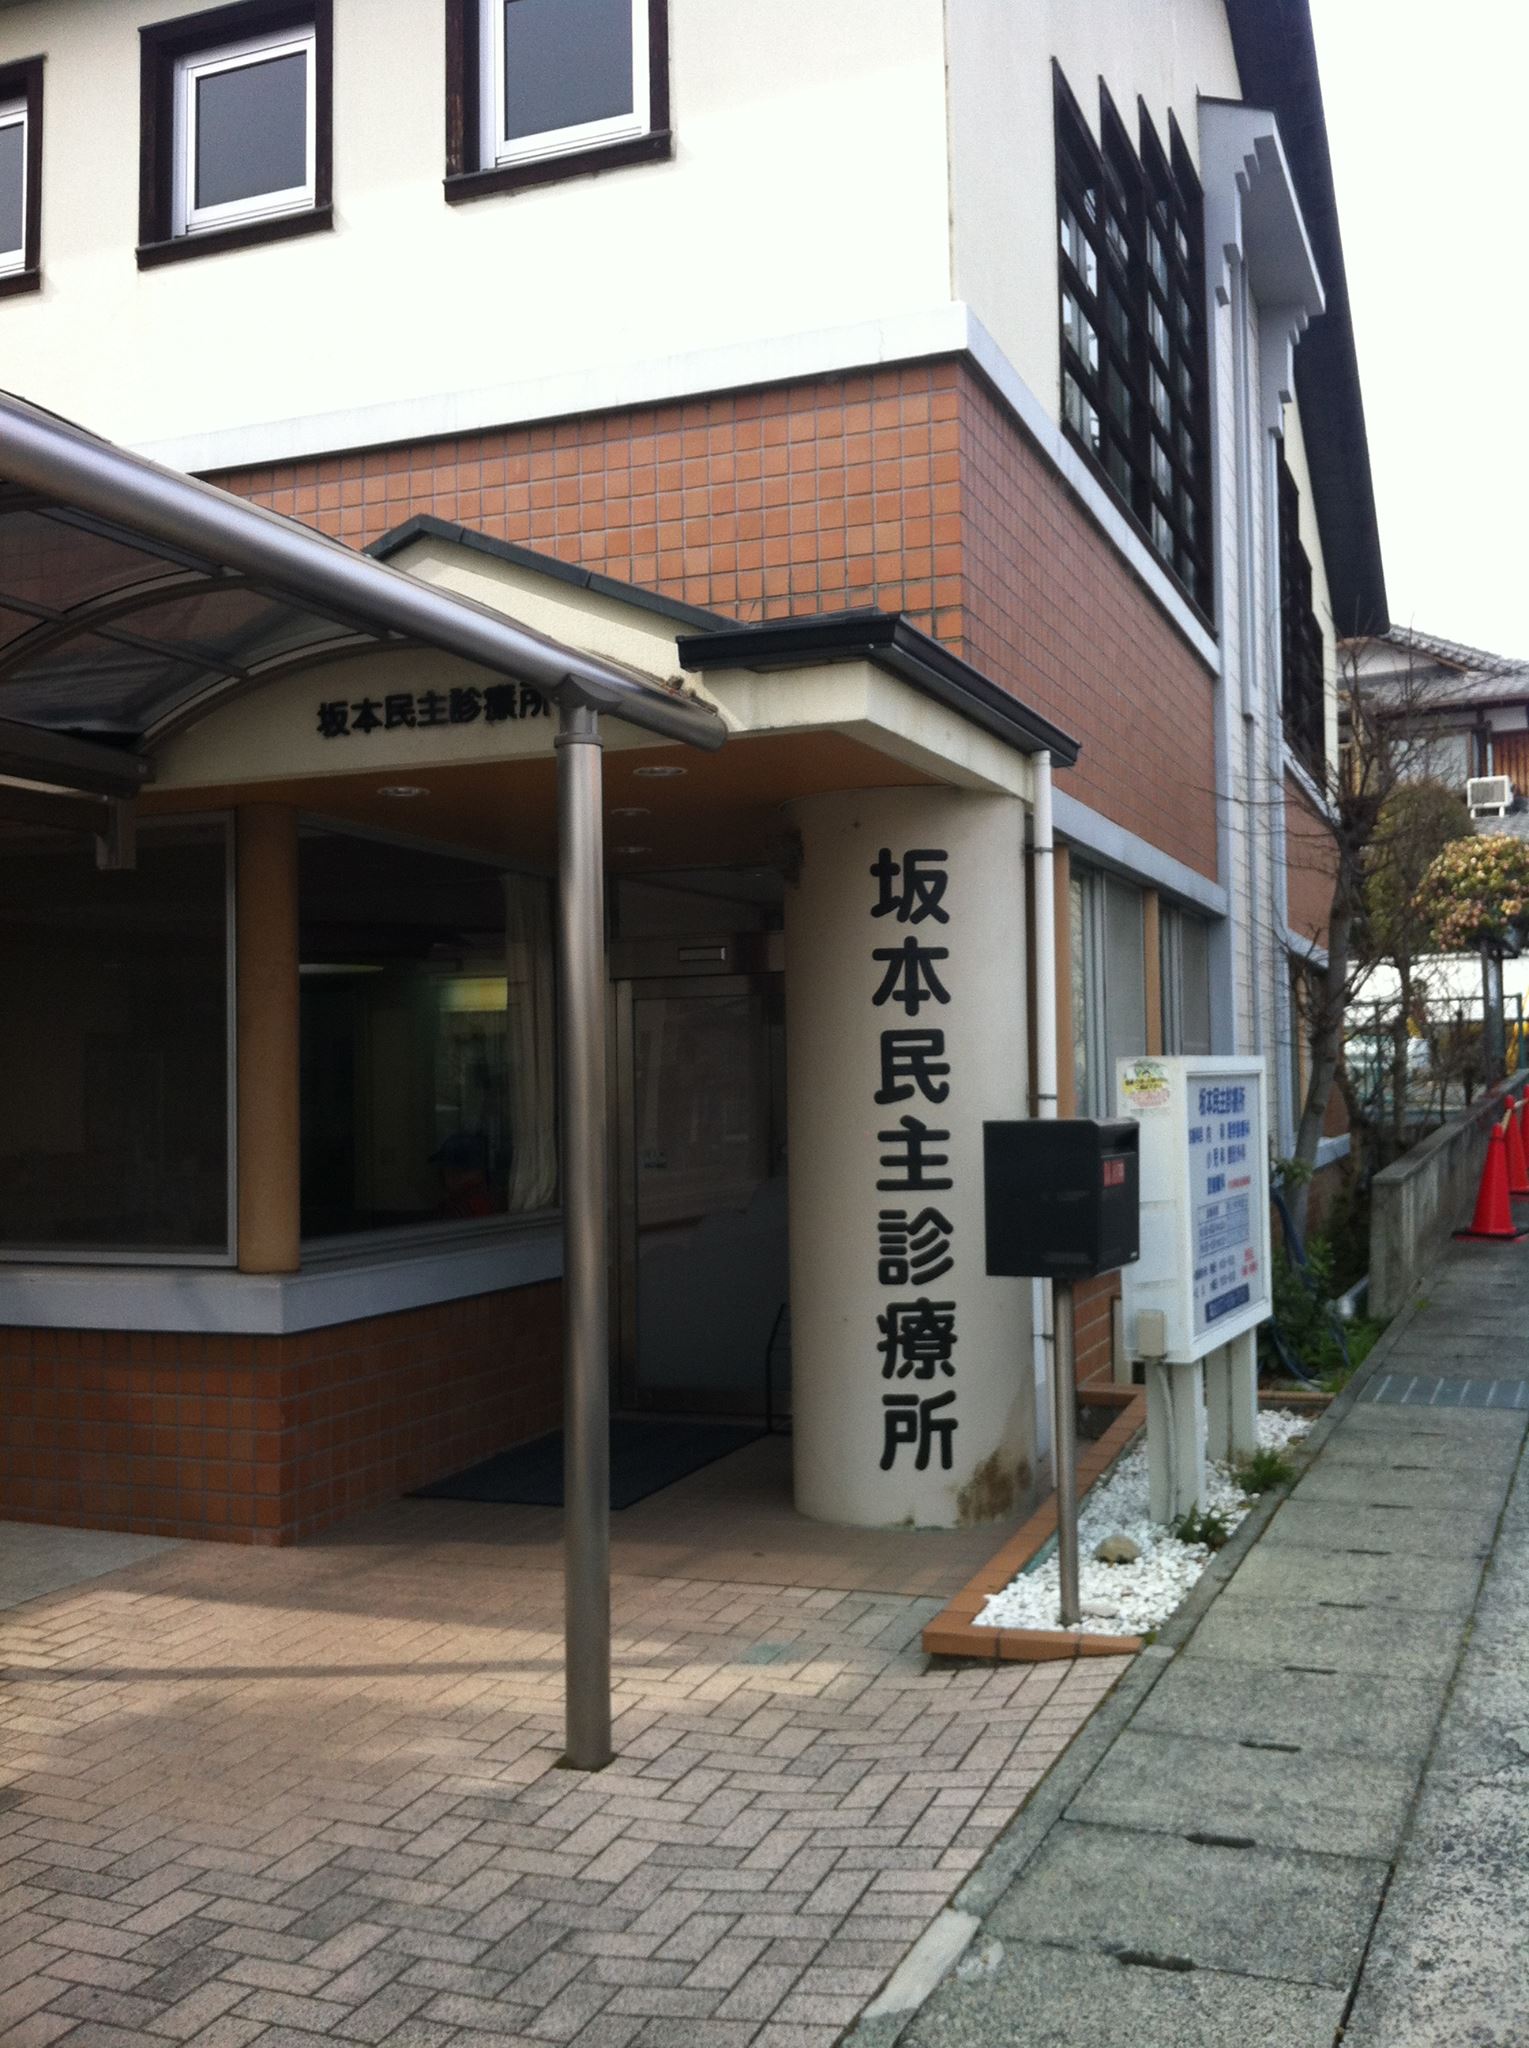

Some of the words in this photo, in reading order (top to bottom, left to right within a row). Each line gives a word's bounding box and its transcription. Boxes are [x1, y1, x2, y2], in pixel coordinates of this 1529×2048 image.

[870, 847, 957, 1471] 坂本民主診療所
